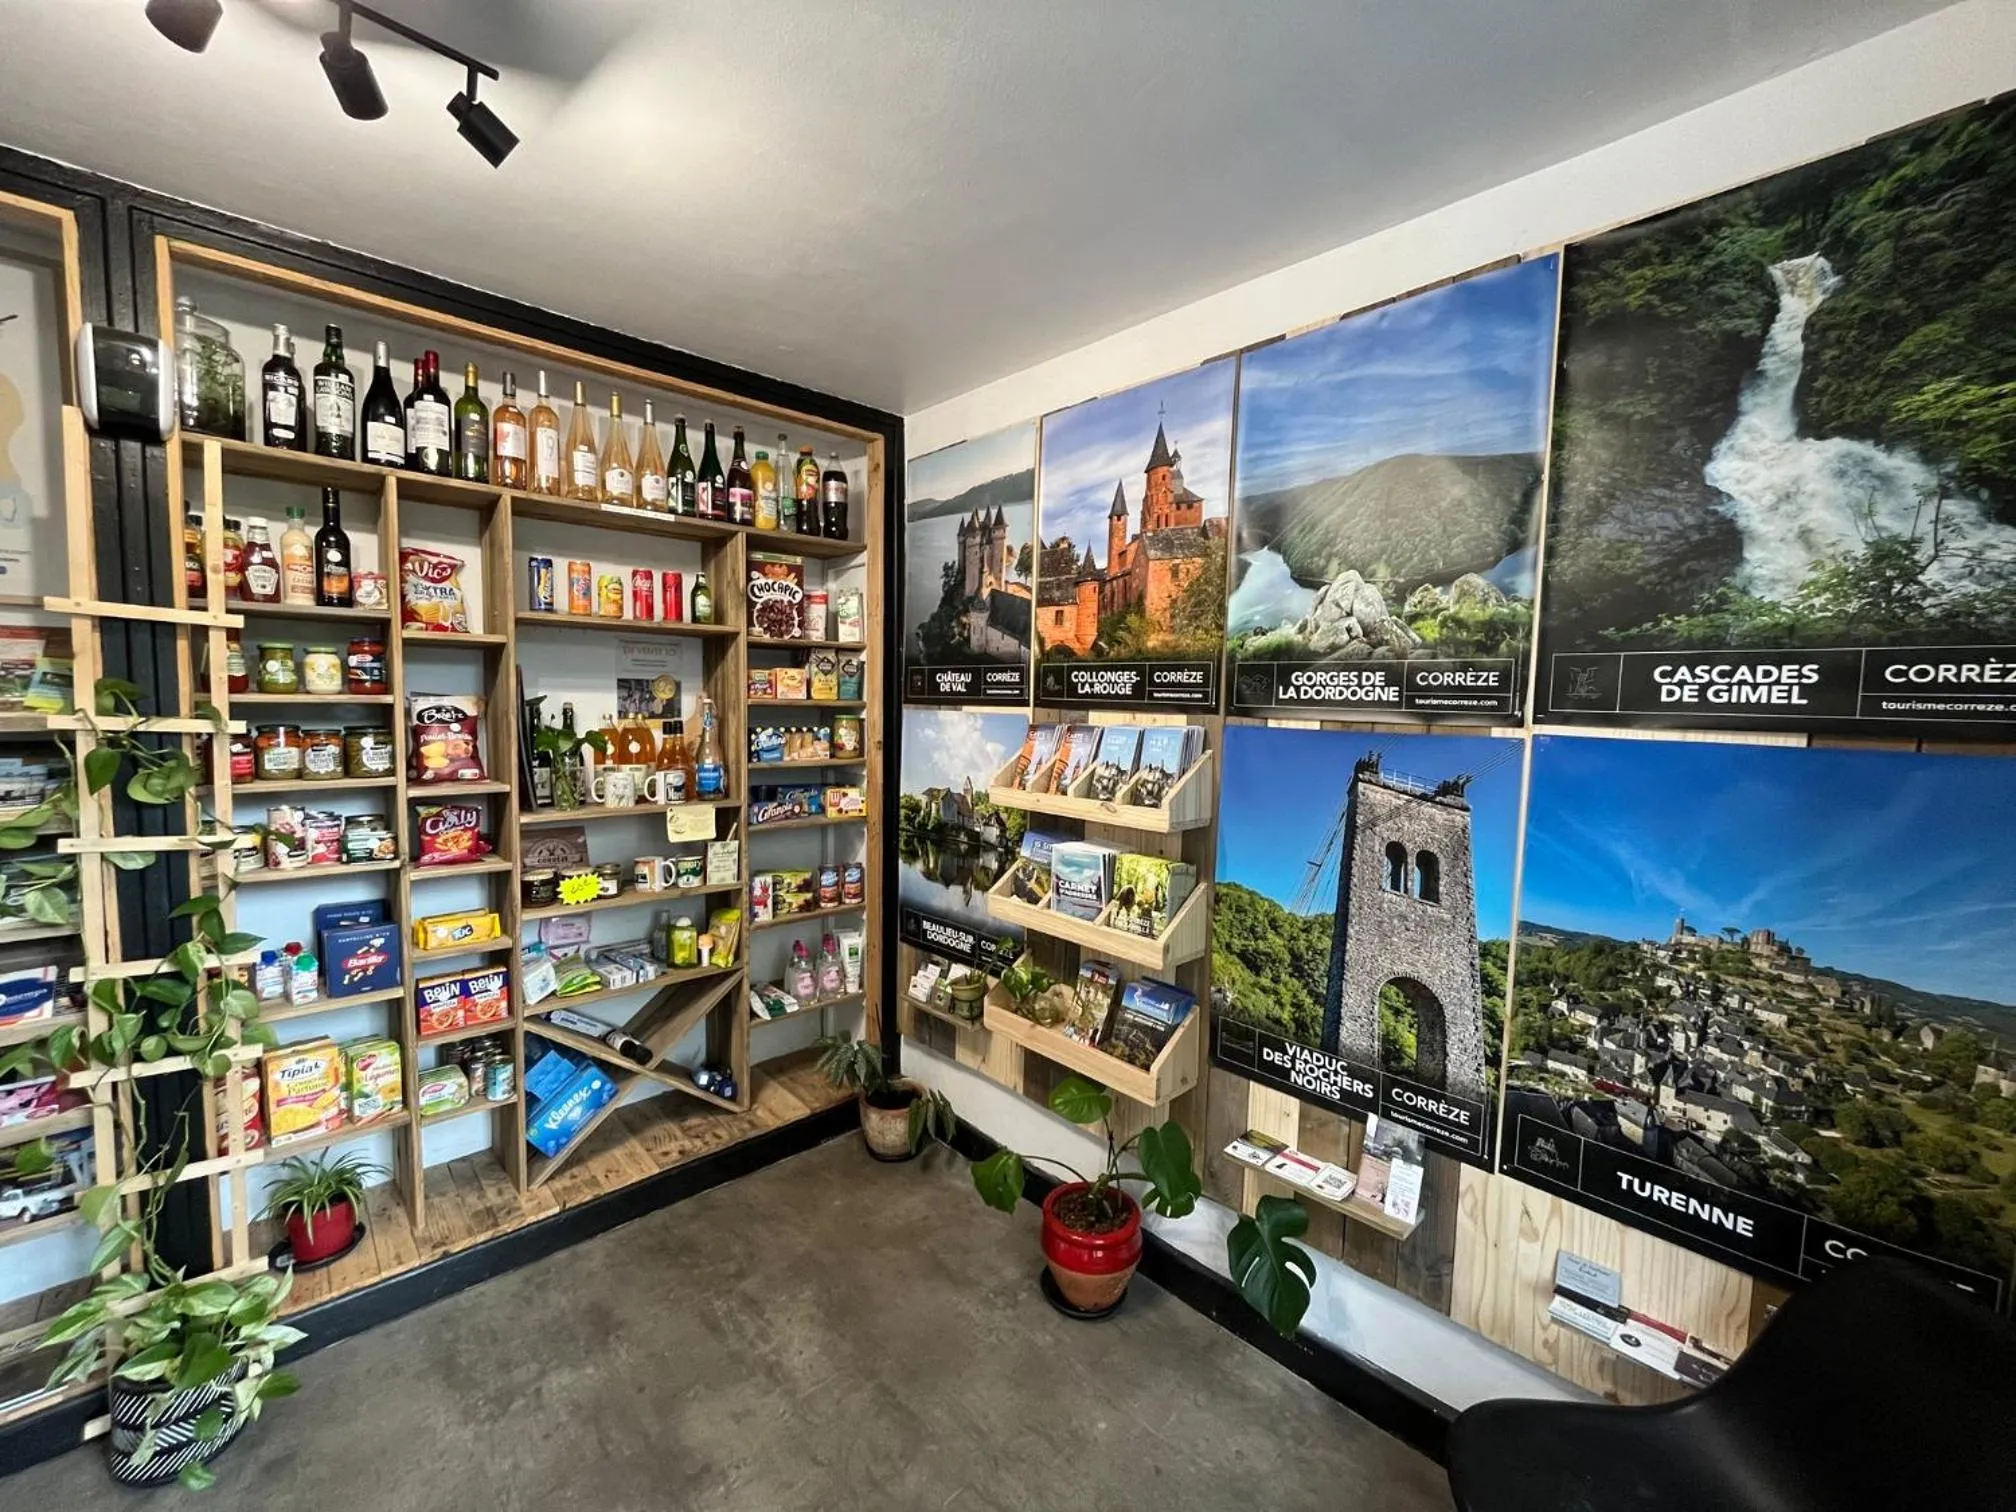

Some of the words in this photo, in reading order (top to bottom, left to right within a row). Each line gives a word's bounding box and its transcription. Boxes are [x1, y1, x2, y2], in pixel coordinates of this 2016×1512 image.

[413, 583, 455, 596] EXTRA
[750, 582, 800, 602] CHOCAPIC
[935, 671, 972, 683] CHÂTEAU
[986, 670, 1020, 682] CORRÈZE
[1071, 671, 1141, 683] COLLONGES-
[1153, 668, 1204, 683] CORRÈZE
[1291, 671, 1358, 686] GORGES
[1361, 671, 1385, 686] DE
[1416, 667, 1500, 686] CORRÈZE
[1652, 664, 1820, 684] CASCADES
[940, 682, 951, 692] DE
[952, 682, 967, 692] VAL
[1077, 683, 1133, 694] LA-ROUGE
[1278, 686, 1297, 699] LA
[1300, 686, 1400, 701] DORDOGNE
[1660, 684, 1700, 702] DE
[1706, 684, 1809, 705] GIMEL
[426, 809, 476, 835] Curly
[757, 802, 793, 822] Granola
[1059, 880, 1097, 893] CARNET
[922, 920, 975, 944] BEAULIEU-SUR-
[927, 930, 972, 953] DORDOGNE
[1284, 1042, 1348, 1076] VIADUC
[1263, 1047, 1292, 1069] DES
[1295, 1058, 1374, 1098] ROCHERS
[1290, 1070, 1341, 1100] NOIRS
[544, 1086, 592, 1130] Kleenex
[1391, 1087, 1471, 1126] CORRÈZE
[1616, 1171, 1755, 1238] TURENNE
